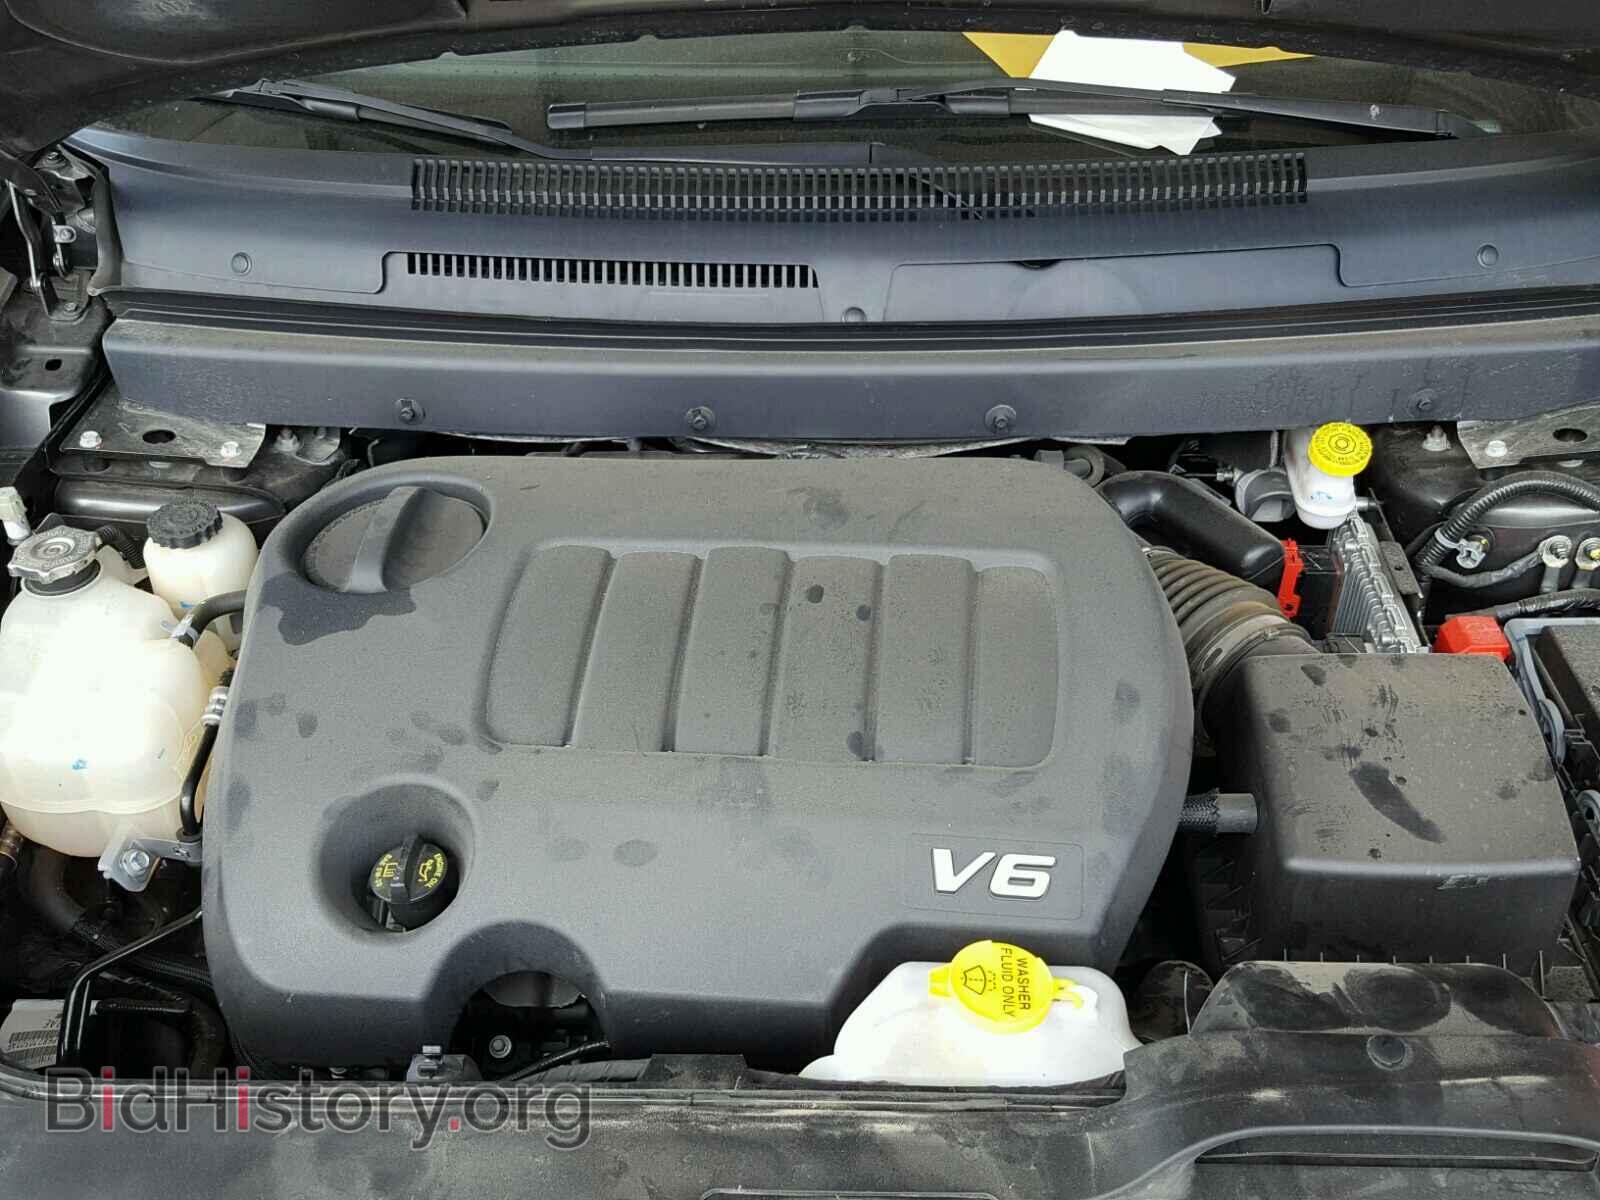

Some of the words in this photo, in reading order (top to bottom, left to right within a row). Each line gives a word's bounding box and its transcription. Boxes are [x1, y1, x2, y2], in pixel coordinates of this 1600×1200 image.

[433, 852, 444, 876] ENGINE
[930, 847, 1057, 900] V6
[1000, 947, 1013, 982] FLUID
[1001, 984, 1016, 1017] ONLY
[1015, 957, 1031, 1011] WASHER
